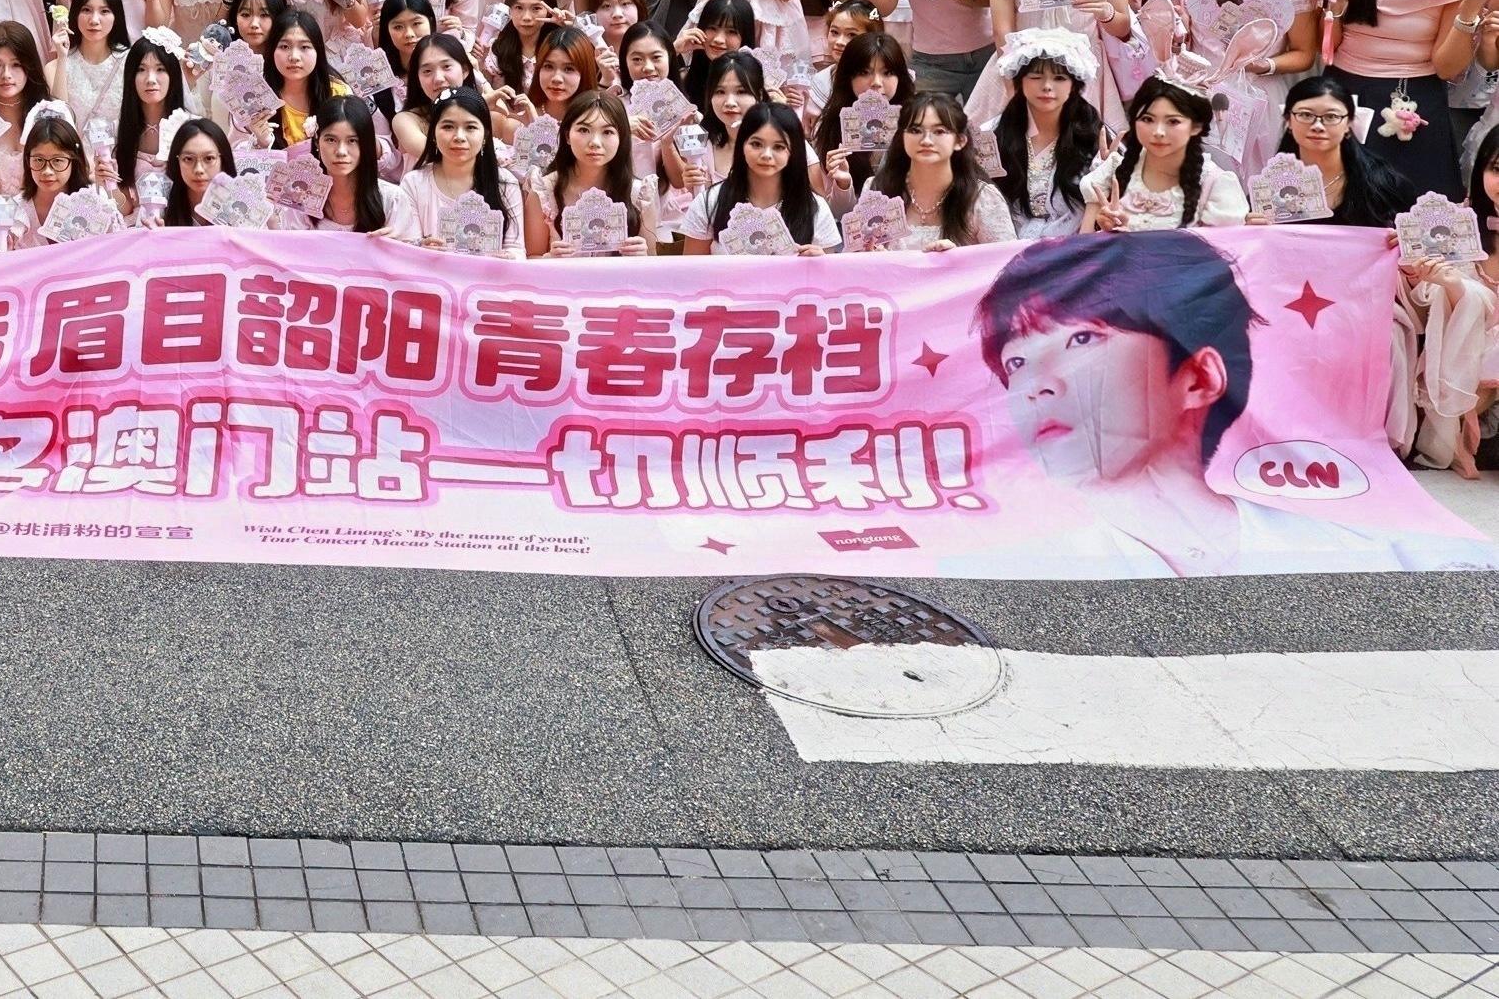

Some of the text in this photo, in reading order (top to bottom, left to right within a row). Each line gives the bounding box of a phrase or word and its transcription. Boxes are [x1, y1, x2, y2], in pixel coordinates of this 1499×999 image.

[29, 273, 443, 381] 眉目韶阳
[472, 299, 883, 397] 青春存档
[1259, 461, 1340, 489] CLN
[244, 525, 282, 534] Wish
[287, 526, 330, 535] Chen
[335, 527, 402, 538] Linong's
[439, 531, 465, 540] the
[468, 533, 515, 542] name
[519, 534, 536, 543] of
[259, 535, 591, 554] Tour Concert Macao Station all the best!
[834, 534, 904, 546] nongtang
